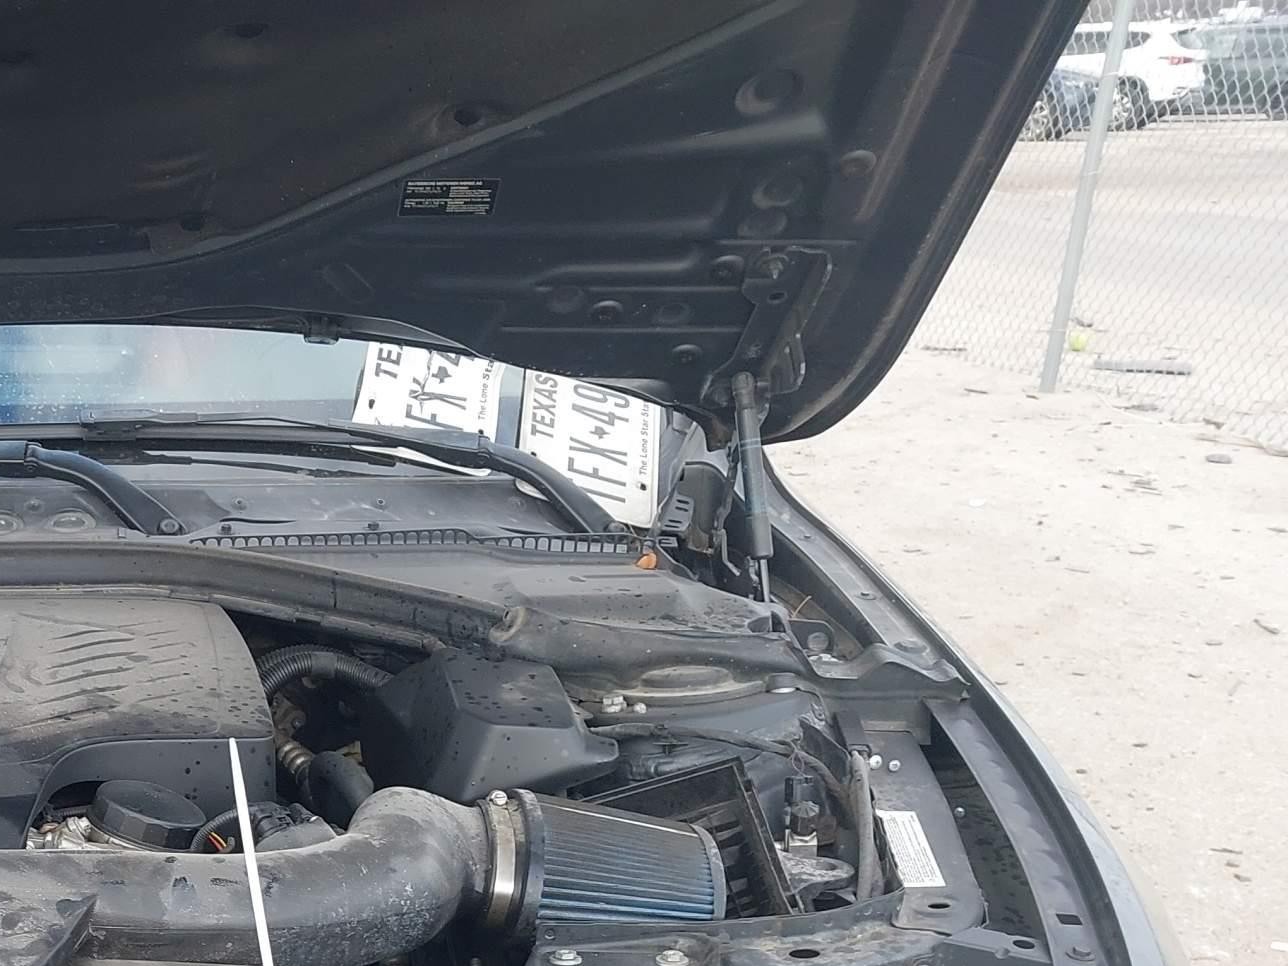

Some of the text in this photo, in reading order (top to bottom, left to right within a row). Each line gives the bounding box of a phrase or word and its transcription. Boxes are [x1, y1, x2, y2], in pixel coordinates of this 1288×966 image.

[375, 342, 403, 379] TE
[479, 383, 489, 404] Lone
[478, 405, 489, 421] The
[530, 373, 559, 439] TEXAS
[640, 418, 650, 436] Star
[639, 438, 649, 459] Lone
[638, 460, 648, 476] The
